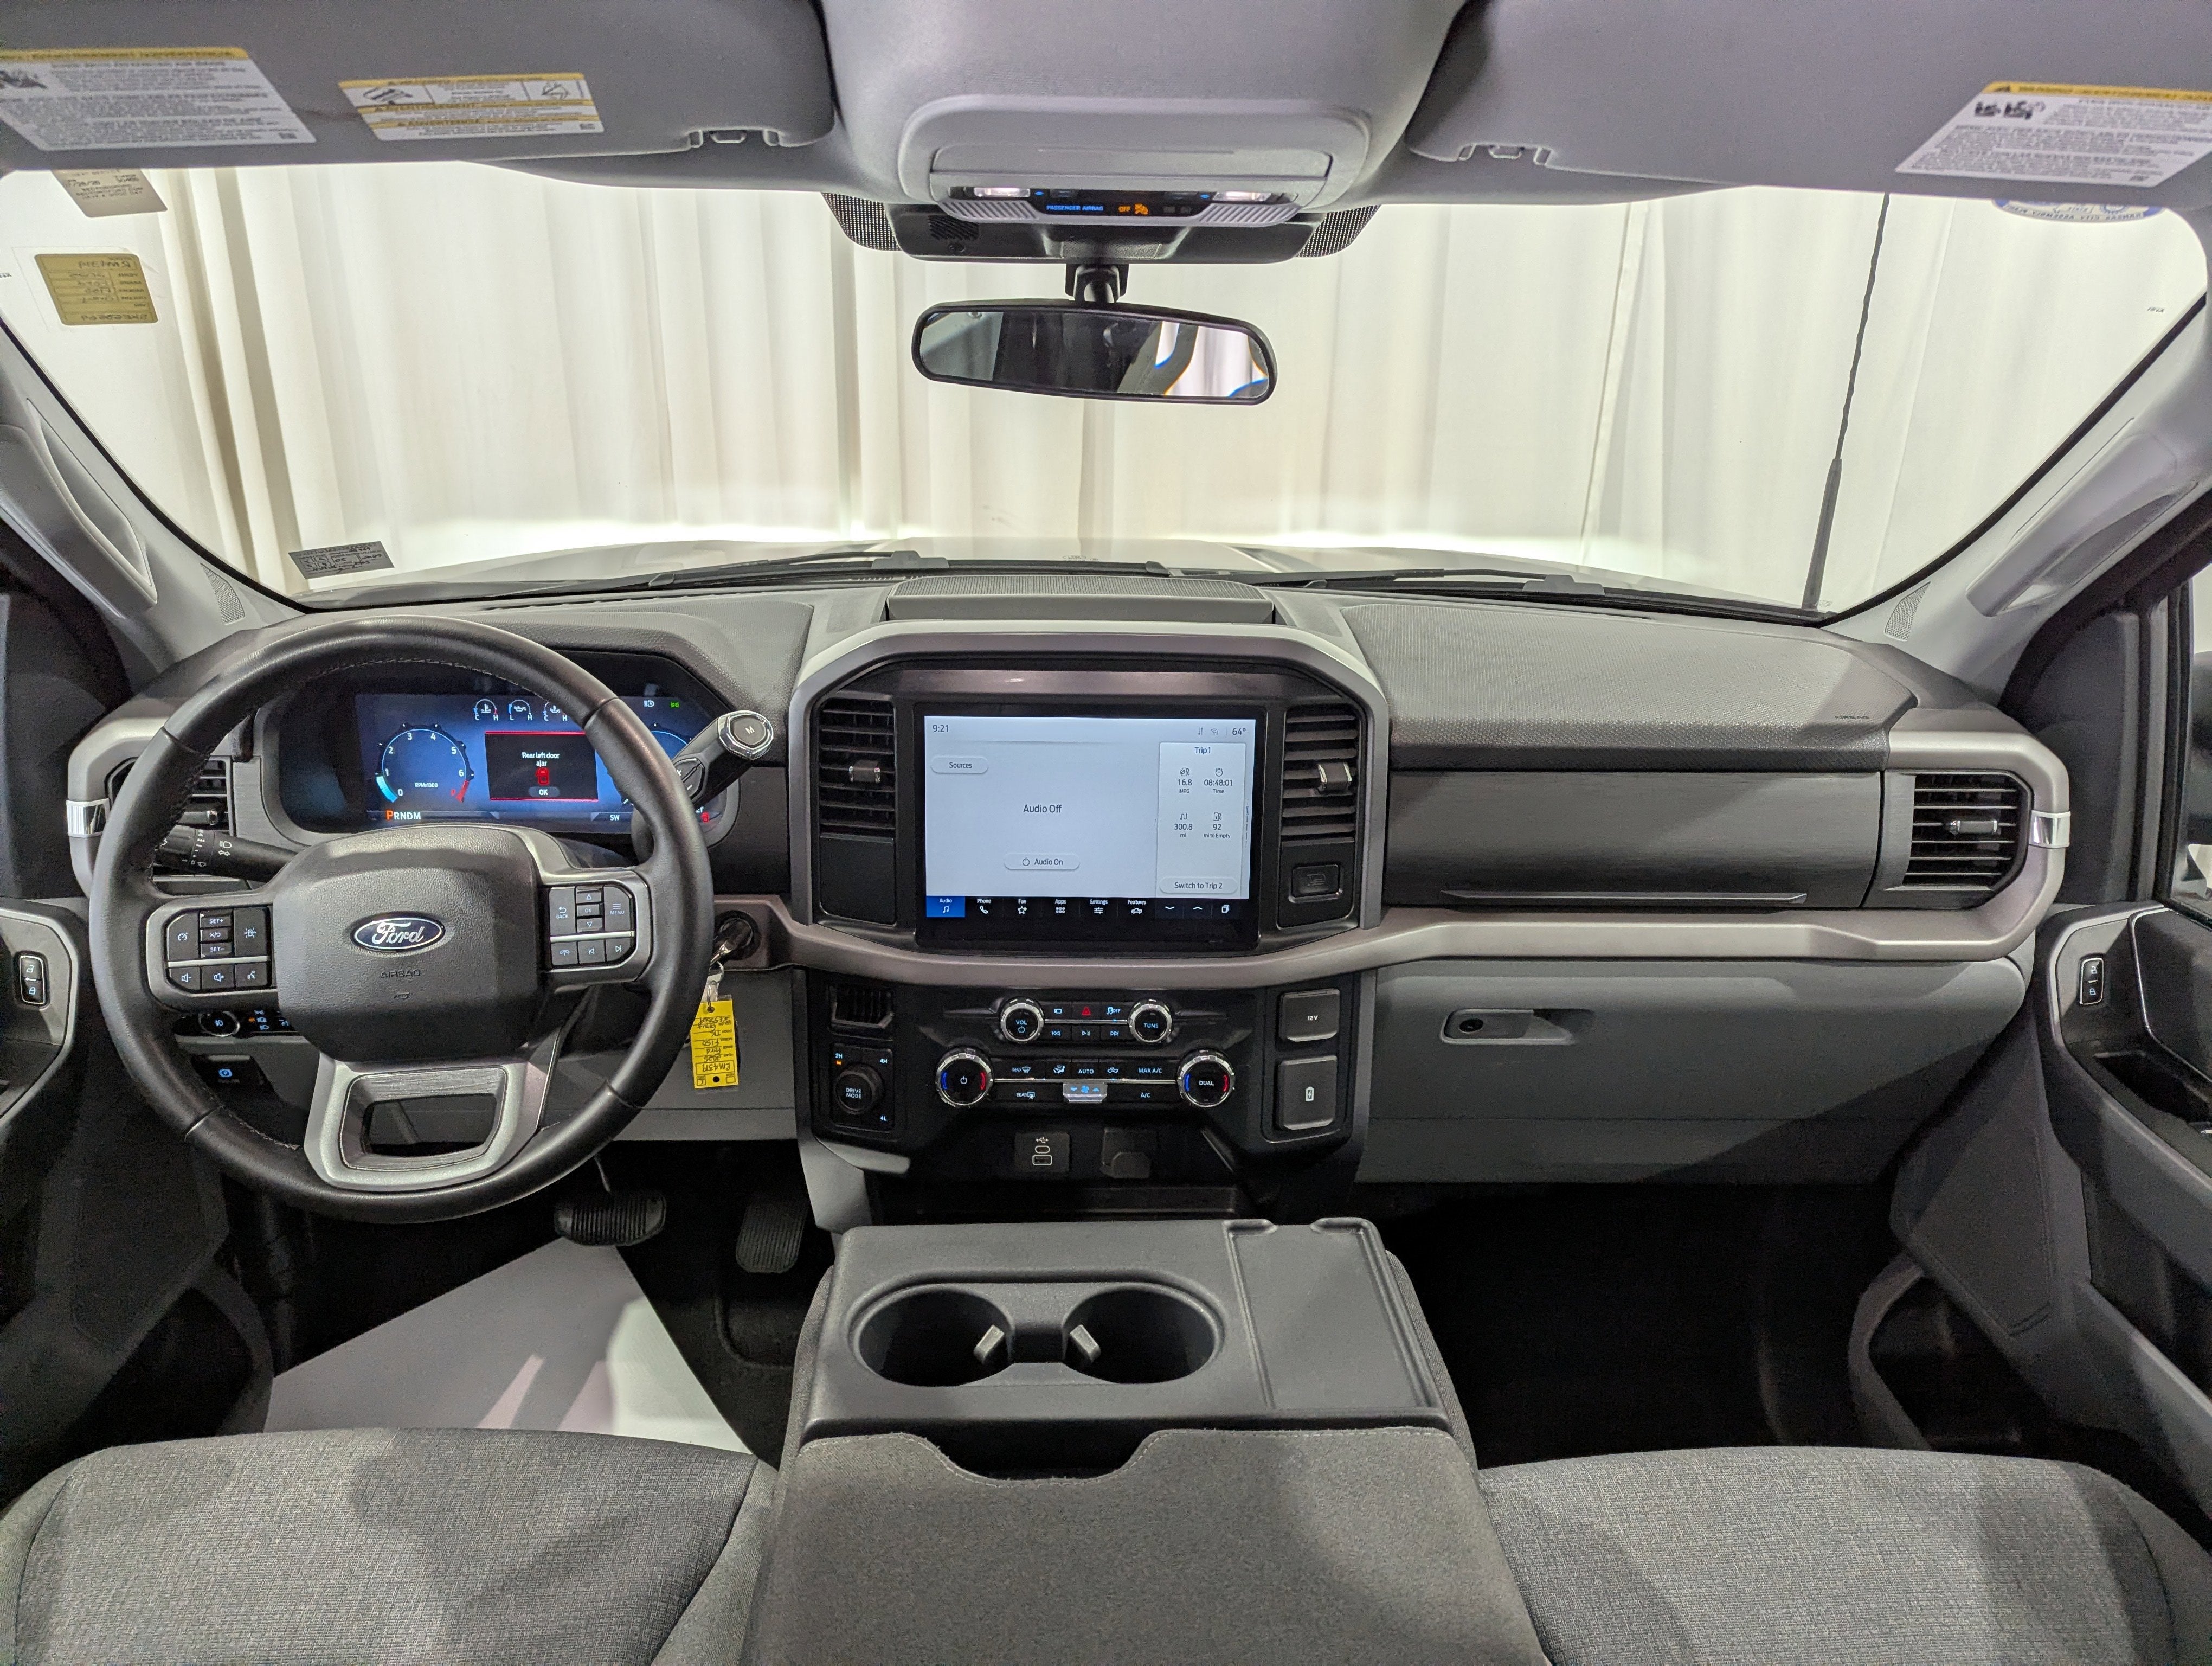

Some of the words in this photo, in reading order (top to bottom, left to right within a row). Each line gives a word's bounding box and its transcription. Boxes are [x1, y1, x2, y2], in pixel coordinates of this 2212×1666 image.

[745, 726, 755, 734] M
[933, 725, 949, 733] 9:21
[451, 746, 456, 754] 5
[1194, 747, 1207, 755] Trip
[1023, 804, 1047, 813] Audio
[1049, 804, 1062, 813] Off
[1034, 858, 1053, 866] Audio
[1205, 882, 1218, 890] Trip
[372, 922, 425, 945] Ford
[380, 968, 421, 978] AIRBAG
